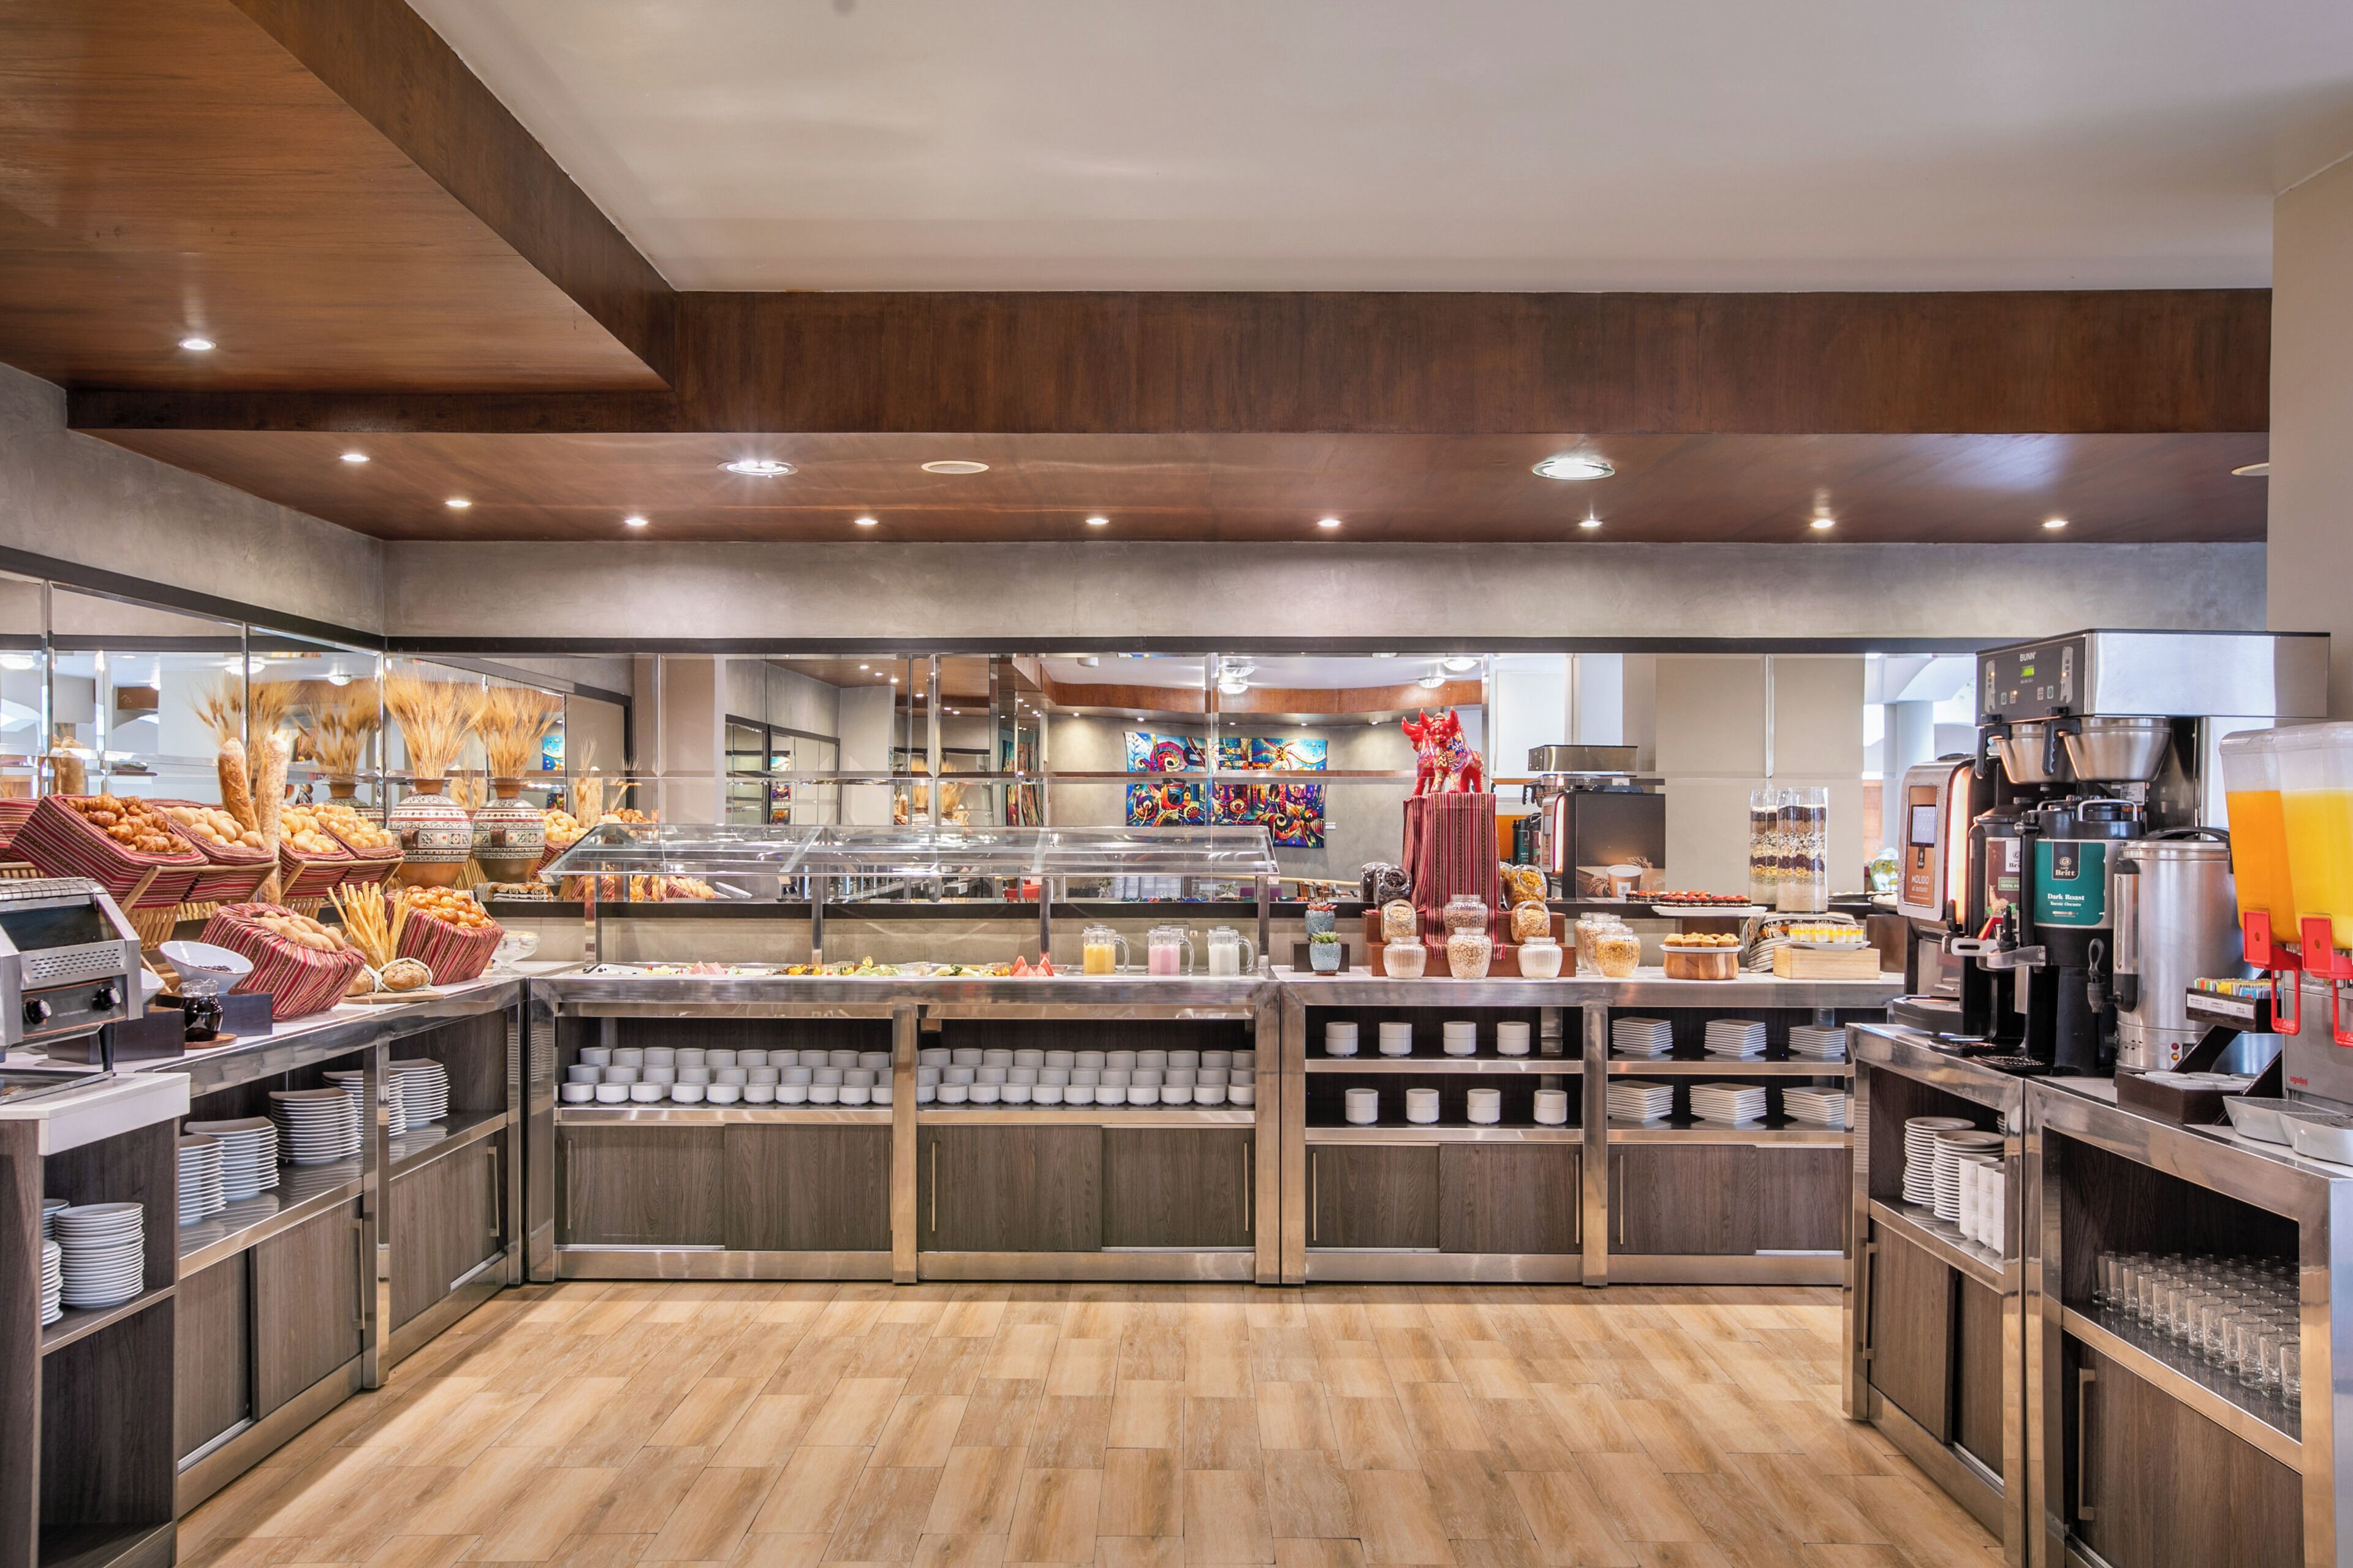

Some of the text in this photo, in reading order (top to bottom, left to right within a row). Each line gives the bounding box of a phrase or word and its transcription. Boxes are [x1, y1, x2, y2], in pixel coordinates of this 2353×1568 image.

[2020, 653, 2035, 662] BUNN
[1912, 875, 1929, 884] MOLIDO
[2290, 1076, 2308, 1085] ugolini
